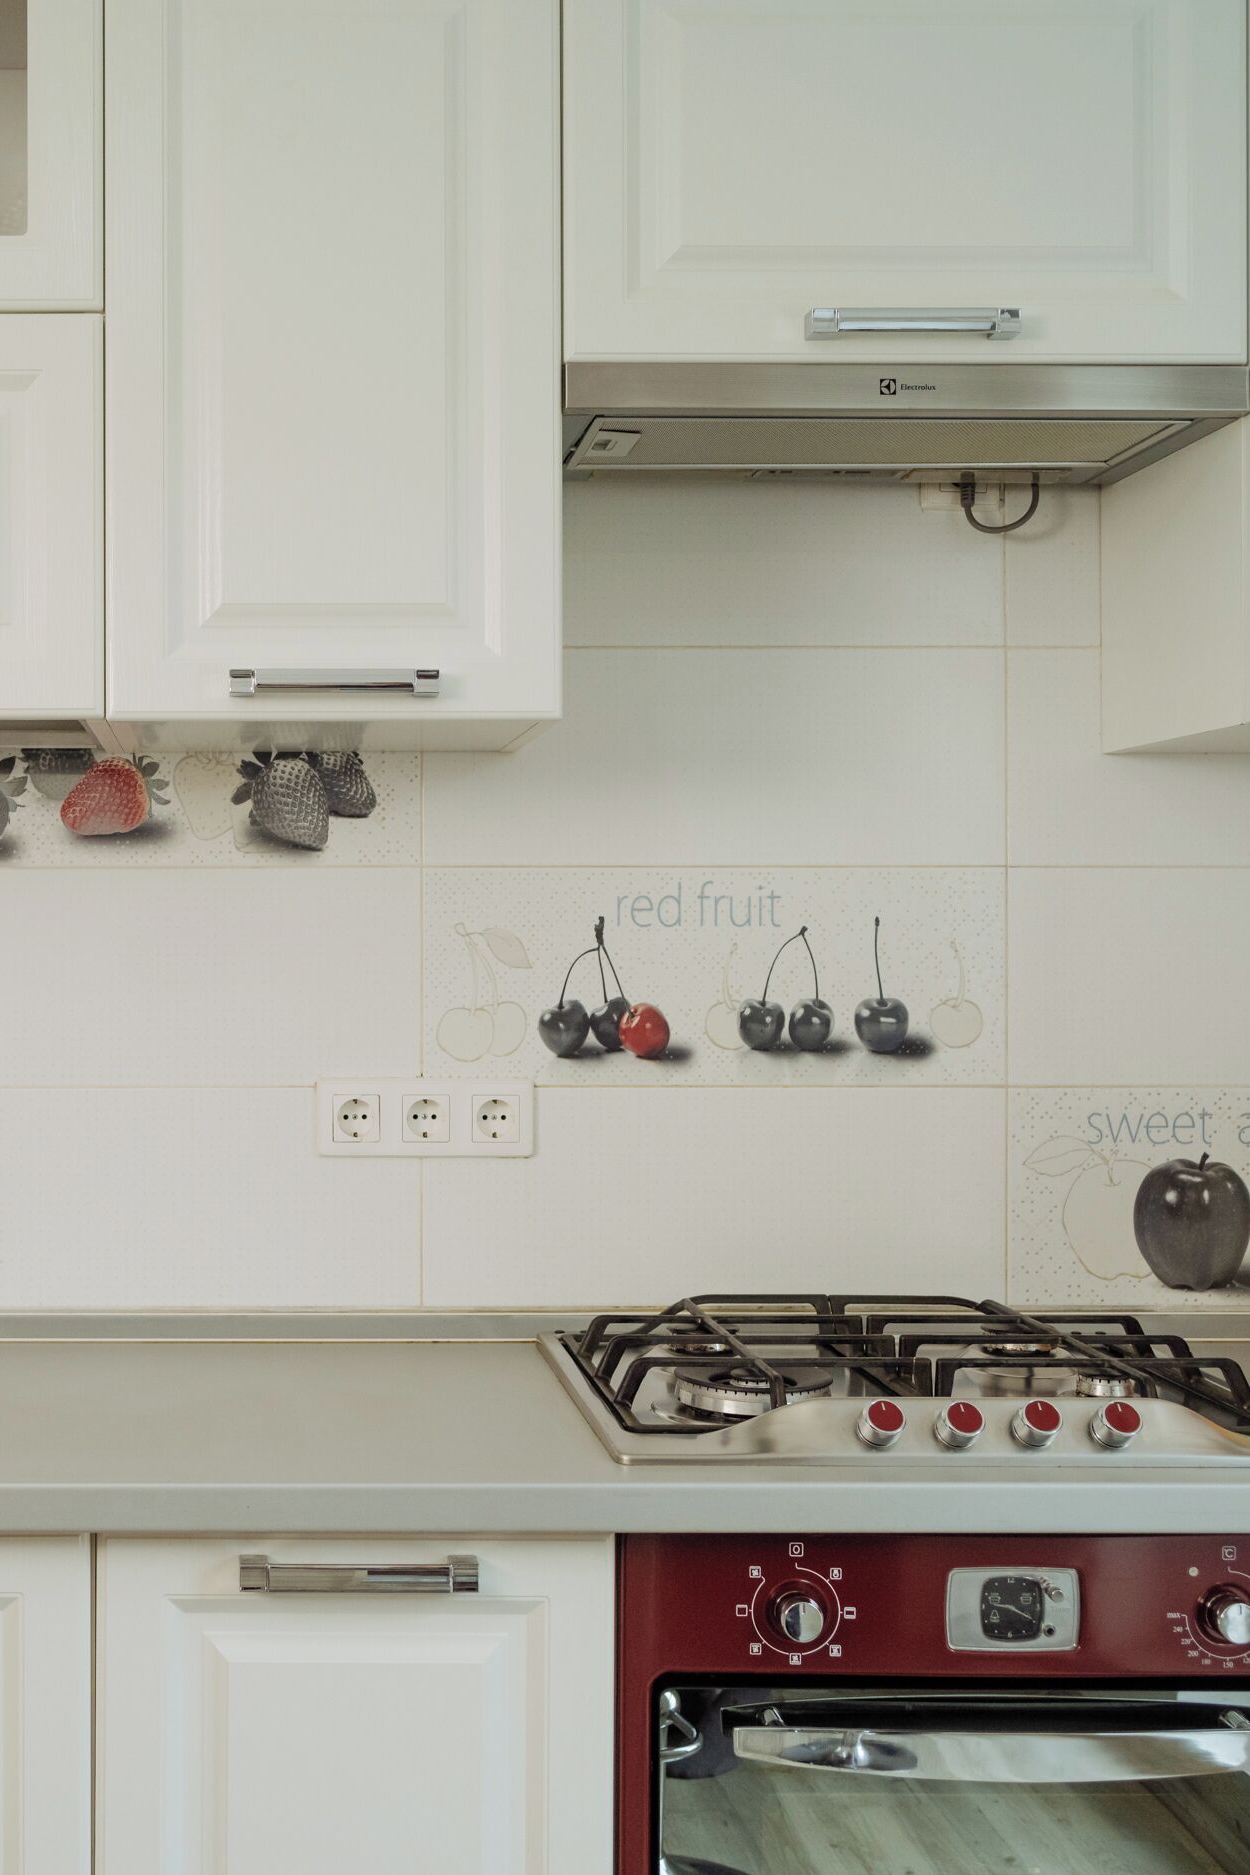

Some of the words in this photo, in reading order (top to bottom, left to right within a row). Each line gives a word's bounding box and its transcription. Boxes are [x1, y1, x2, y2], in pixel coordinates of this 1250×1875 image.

[617, 881, 682, 927] red
[697, 880, 782, 927] fruit
[1087, 1107, 1213, 1145] sweet
[1222, 1661, 1234, 1669] 150
